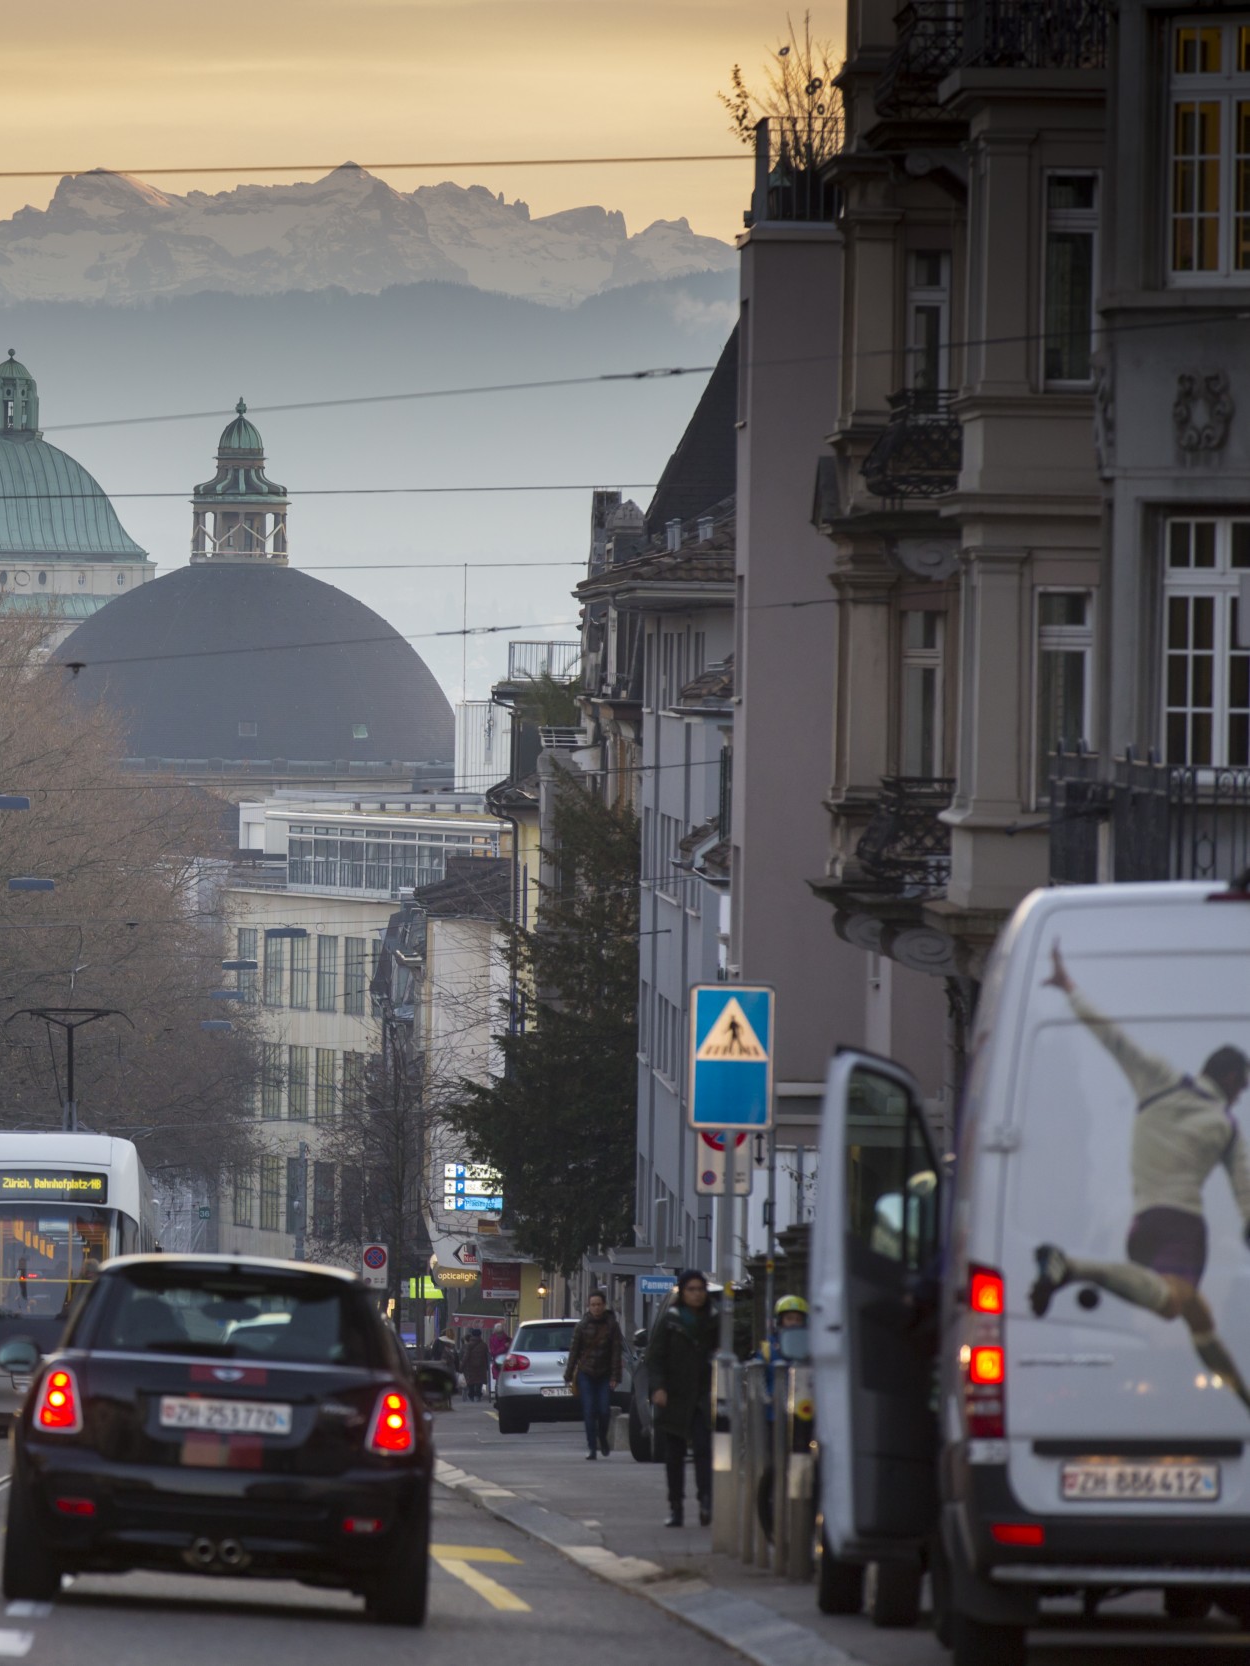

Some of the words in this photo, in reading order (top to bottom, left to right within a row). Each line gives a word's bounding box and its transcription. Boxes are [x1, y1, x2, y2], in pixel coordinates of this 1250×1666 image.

[2, 1177, 32, 1189] Zürich,
[34, 1178, 102, 1191] Bahnhofplatz/HB
[199, 1210, 210, 1218] 36
[437, 1272, 478, 1282] opticalight
